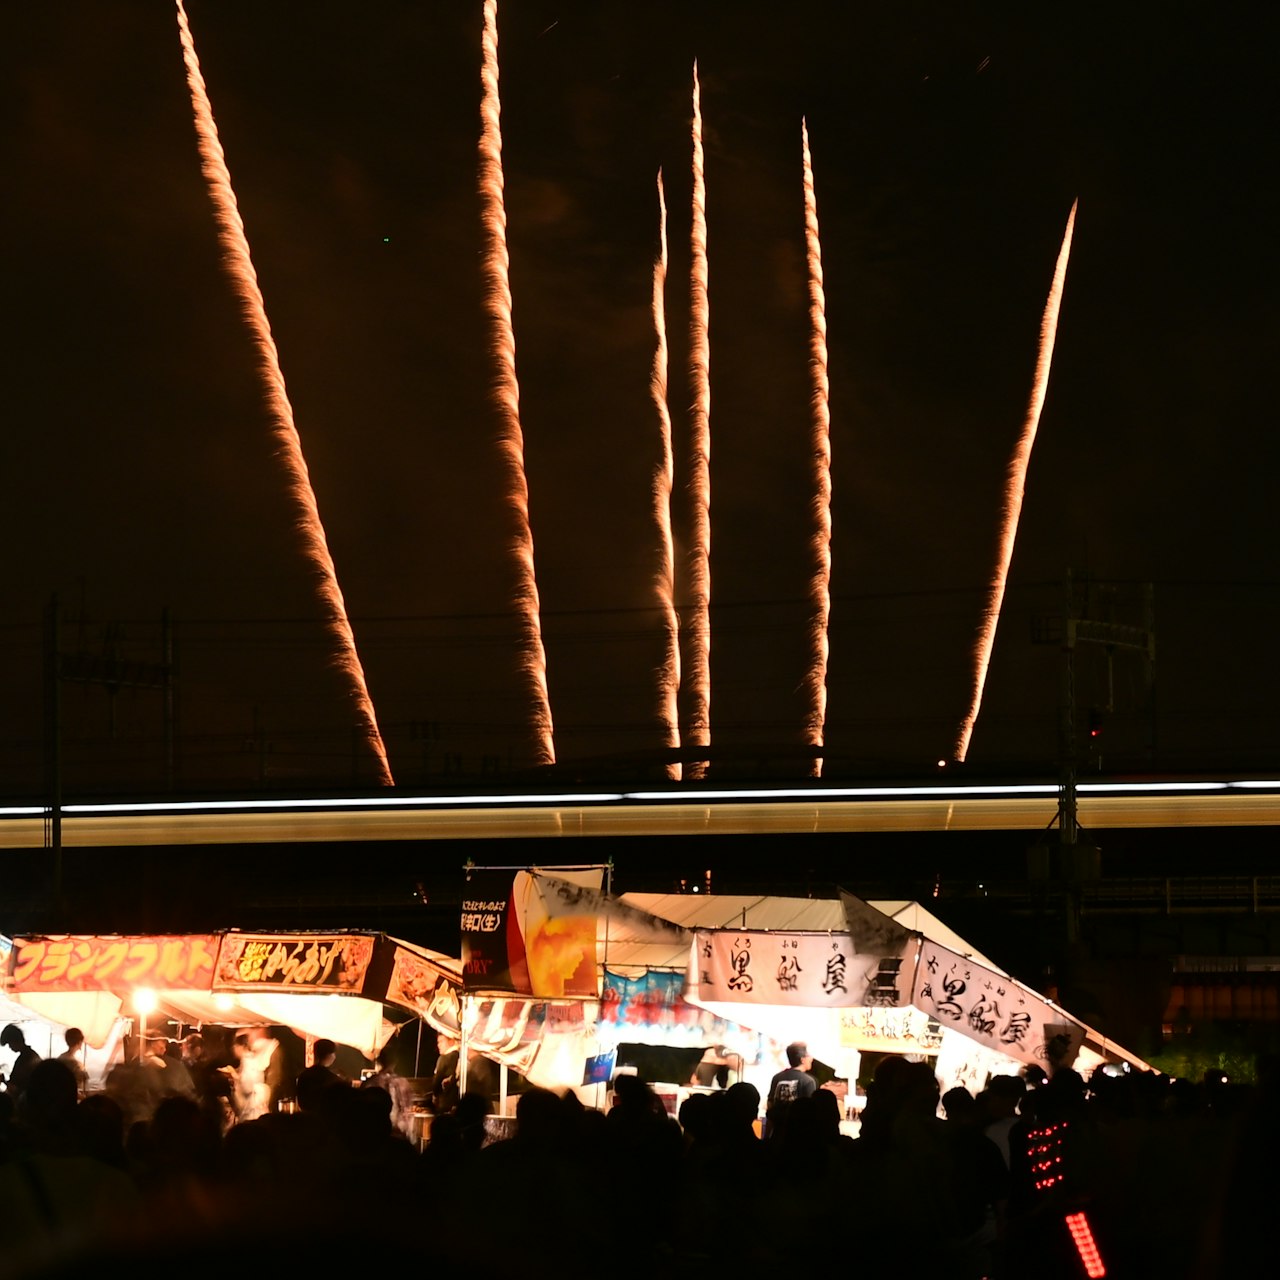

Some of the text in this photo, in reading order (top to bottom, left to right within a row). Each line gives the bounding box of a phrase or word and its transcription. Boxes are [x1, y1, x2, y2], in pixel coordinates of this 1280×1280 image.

[14, 940, 214, 982] フランクフルト
